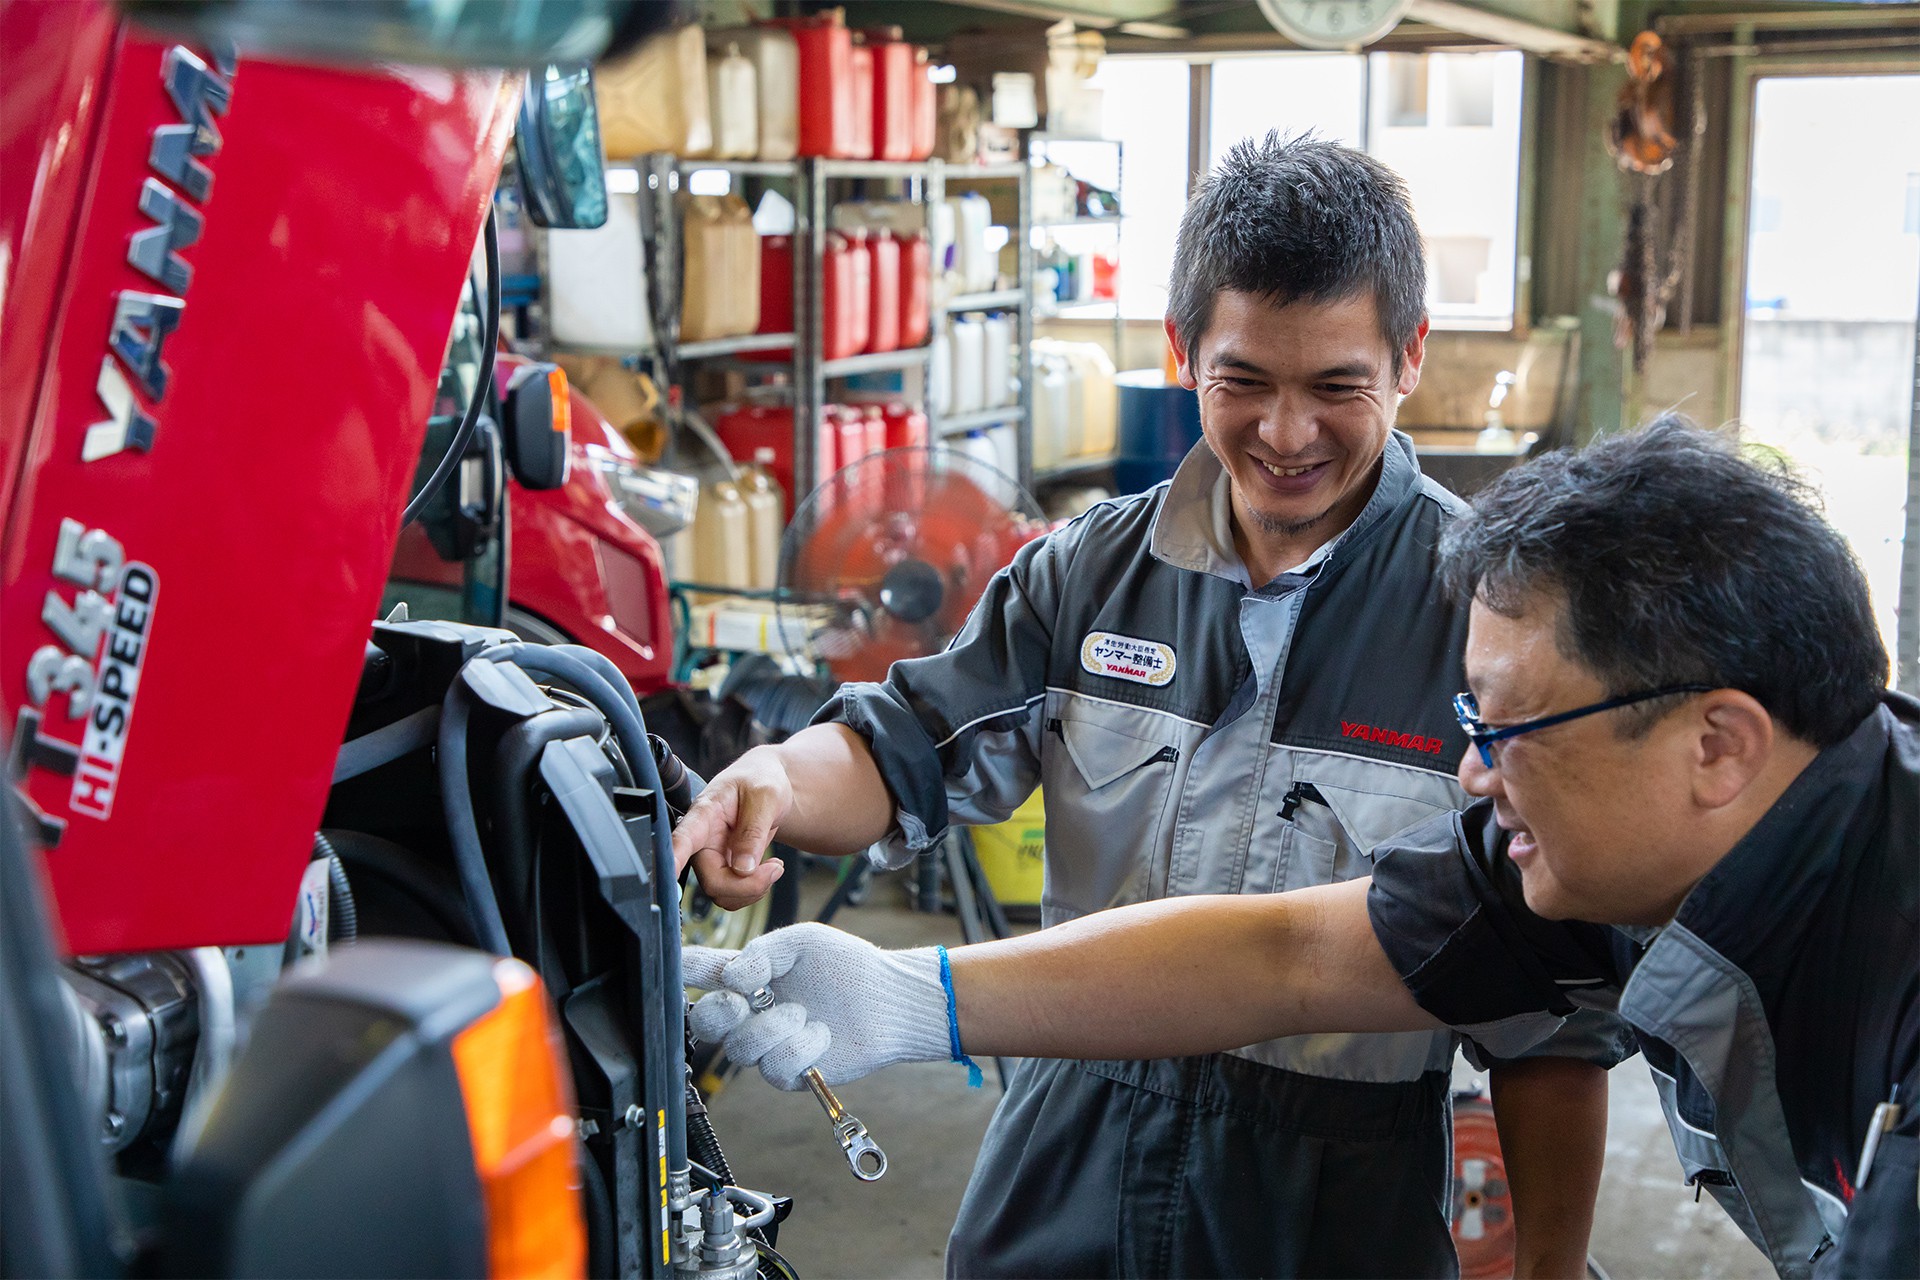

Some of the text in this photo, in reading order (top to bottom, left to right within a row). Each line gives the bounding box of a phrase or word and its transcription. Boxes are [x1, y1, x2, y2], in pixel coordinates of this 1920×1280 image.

[1095, 646, 1163, 669] ヤンマー整備士
[1106, 663, 1147, 678] YANMAR
[75, 568, 154, 812] HI-SPEED
[1341, 721, 1443, 754] YANMAR
